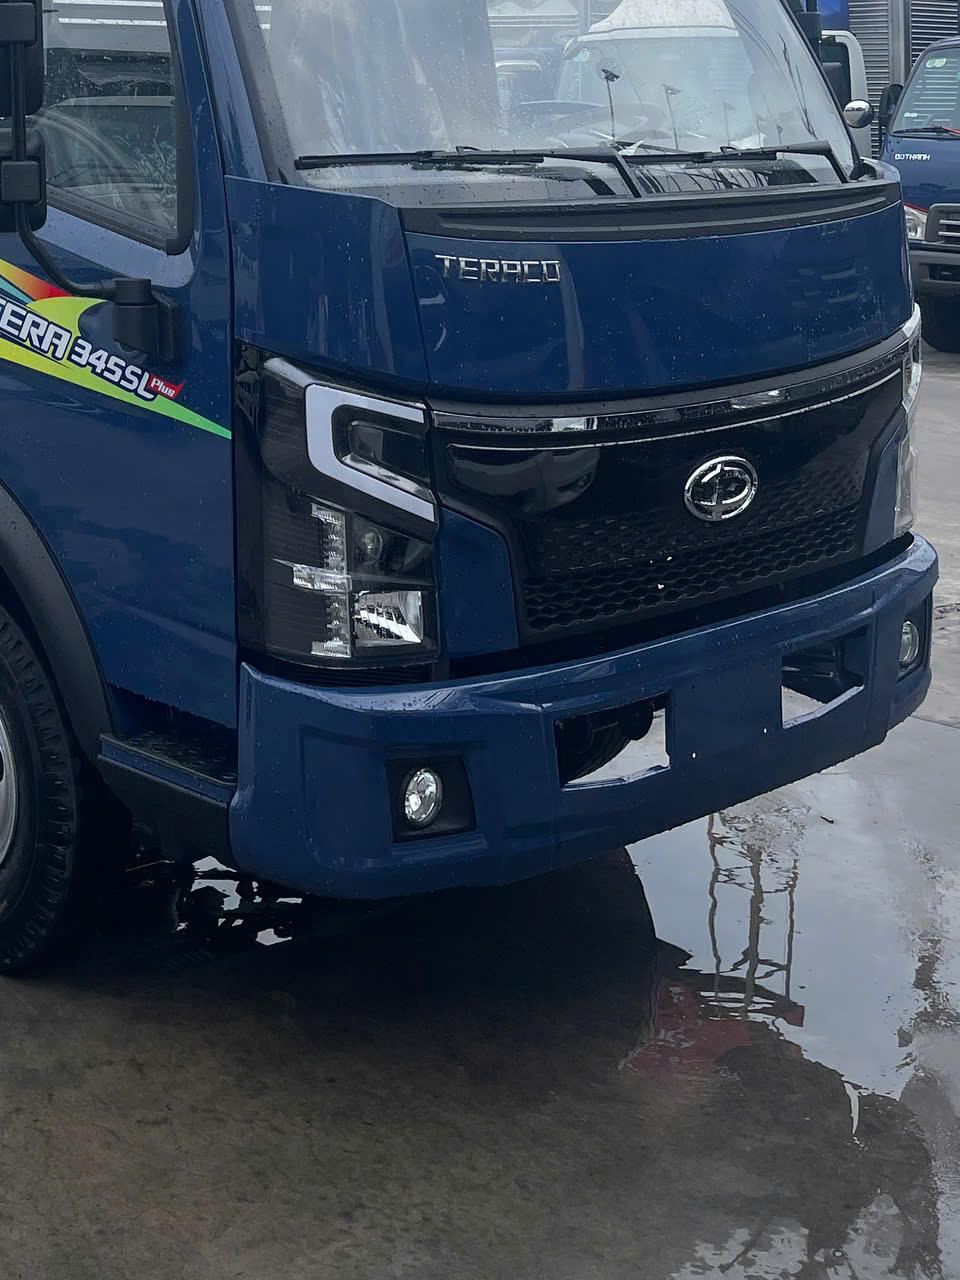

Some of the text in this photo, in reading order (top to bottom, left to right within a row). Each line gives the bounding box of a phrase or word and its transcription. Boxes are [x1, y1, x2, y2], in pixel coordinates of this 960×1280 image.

[435, 254, 561, 282] TERACO
[70, 339, 155, 400] 345SL
[150, 377, 176, 398] Plus
